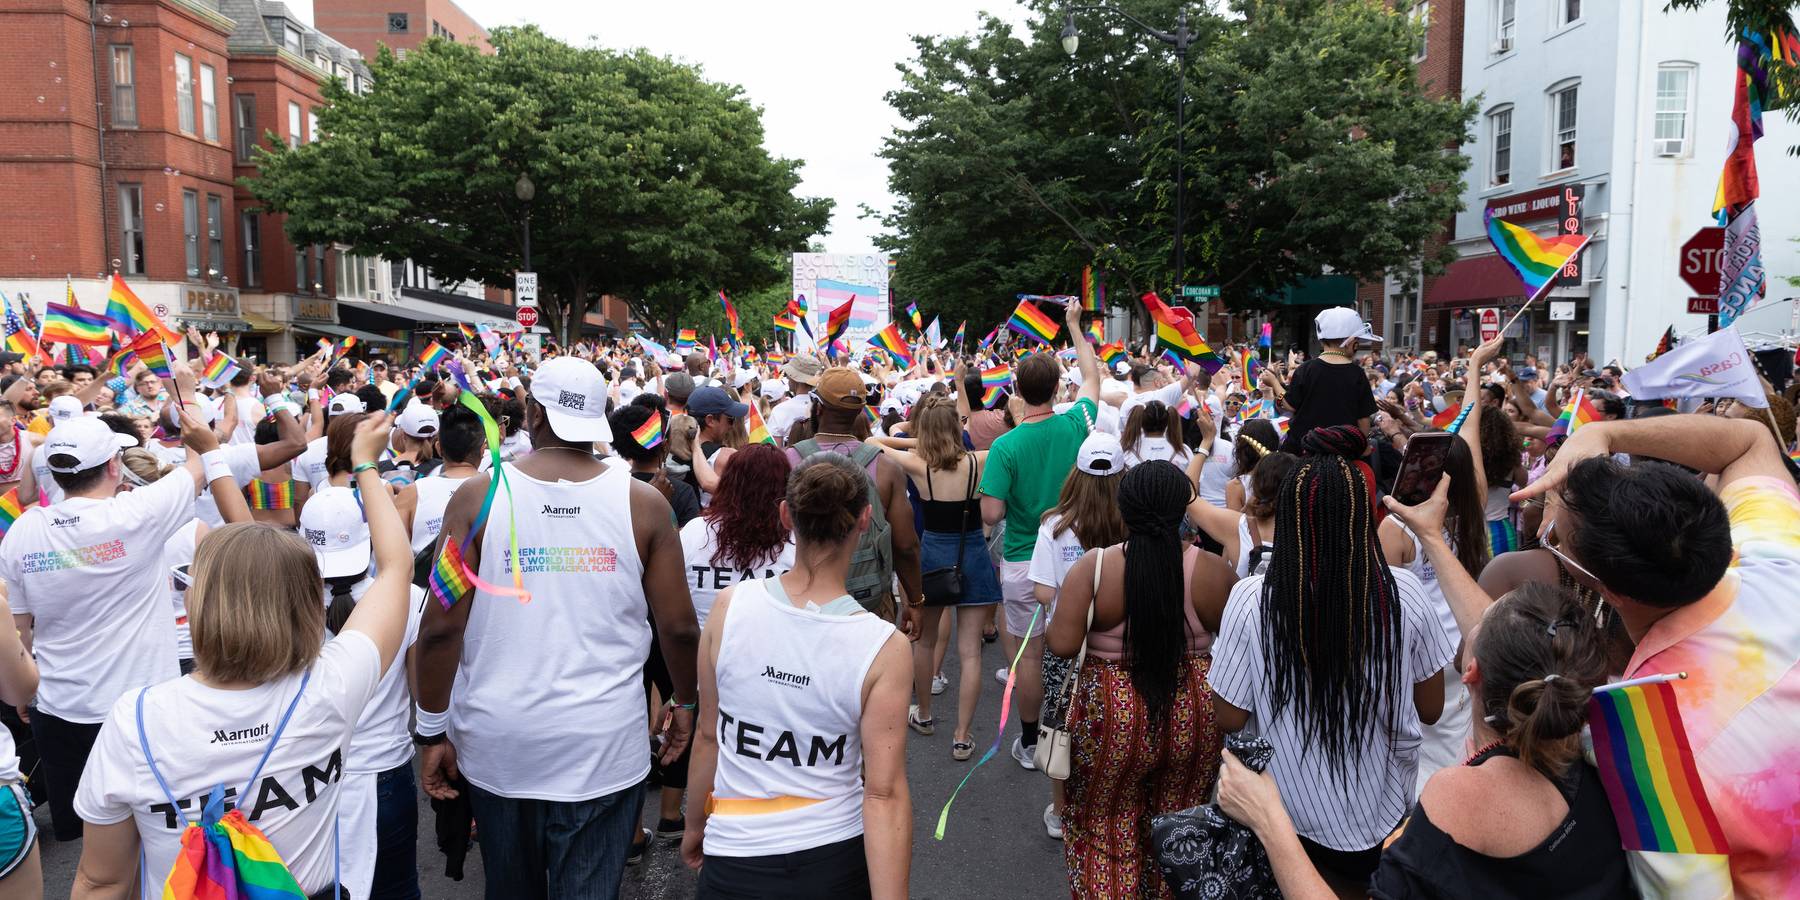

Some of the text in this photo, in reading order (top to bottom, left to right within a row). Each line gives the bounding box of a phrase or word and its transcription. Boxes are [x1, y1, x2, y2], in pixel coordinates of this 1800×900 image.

[1508, 202, 1527, 216] WINE
[1563, 187, 1579, 278] LIQR
[1685, 248, 1724, 274] ST
[518, 276, 535, 285] ONE
[187, 290, 236, 311] PREGO
[1691, 301, 1711, 311] ALL
[518, 312, 537, 321] STOP
[558, 399, 584, 411] PEACE
[541, 504, 581, 515] Marriott
[50, 515, 80, 526] Marriott
[505, 557, 524, 566] TE
[528, 557, 561, 565] WORLD
[578, 557, 585, 565] A
[589, 556, 617, 565] MORE
[22, 566, 54, 574] NCLUSIVE
[505, 566, 545, 574] INUSIVE
[692, 565, 789, 589] TEA
[761, 665, 810, 686] Marriott
[210, 722, 269, 744] Marriott
[718, 707, 848, 767] TEAM
[150, 746, 343, 829] TEAM
